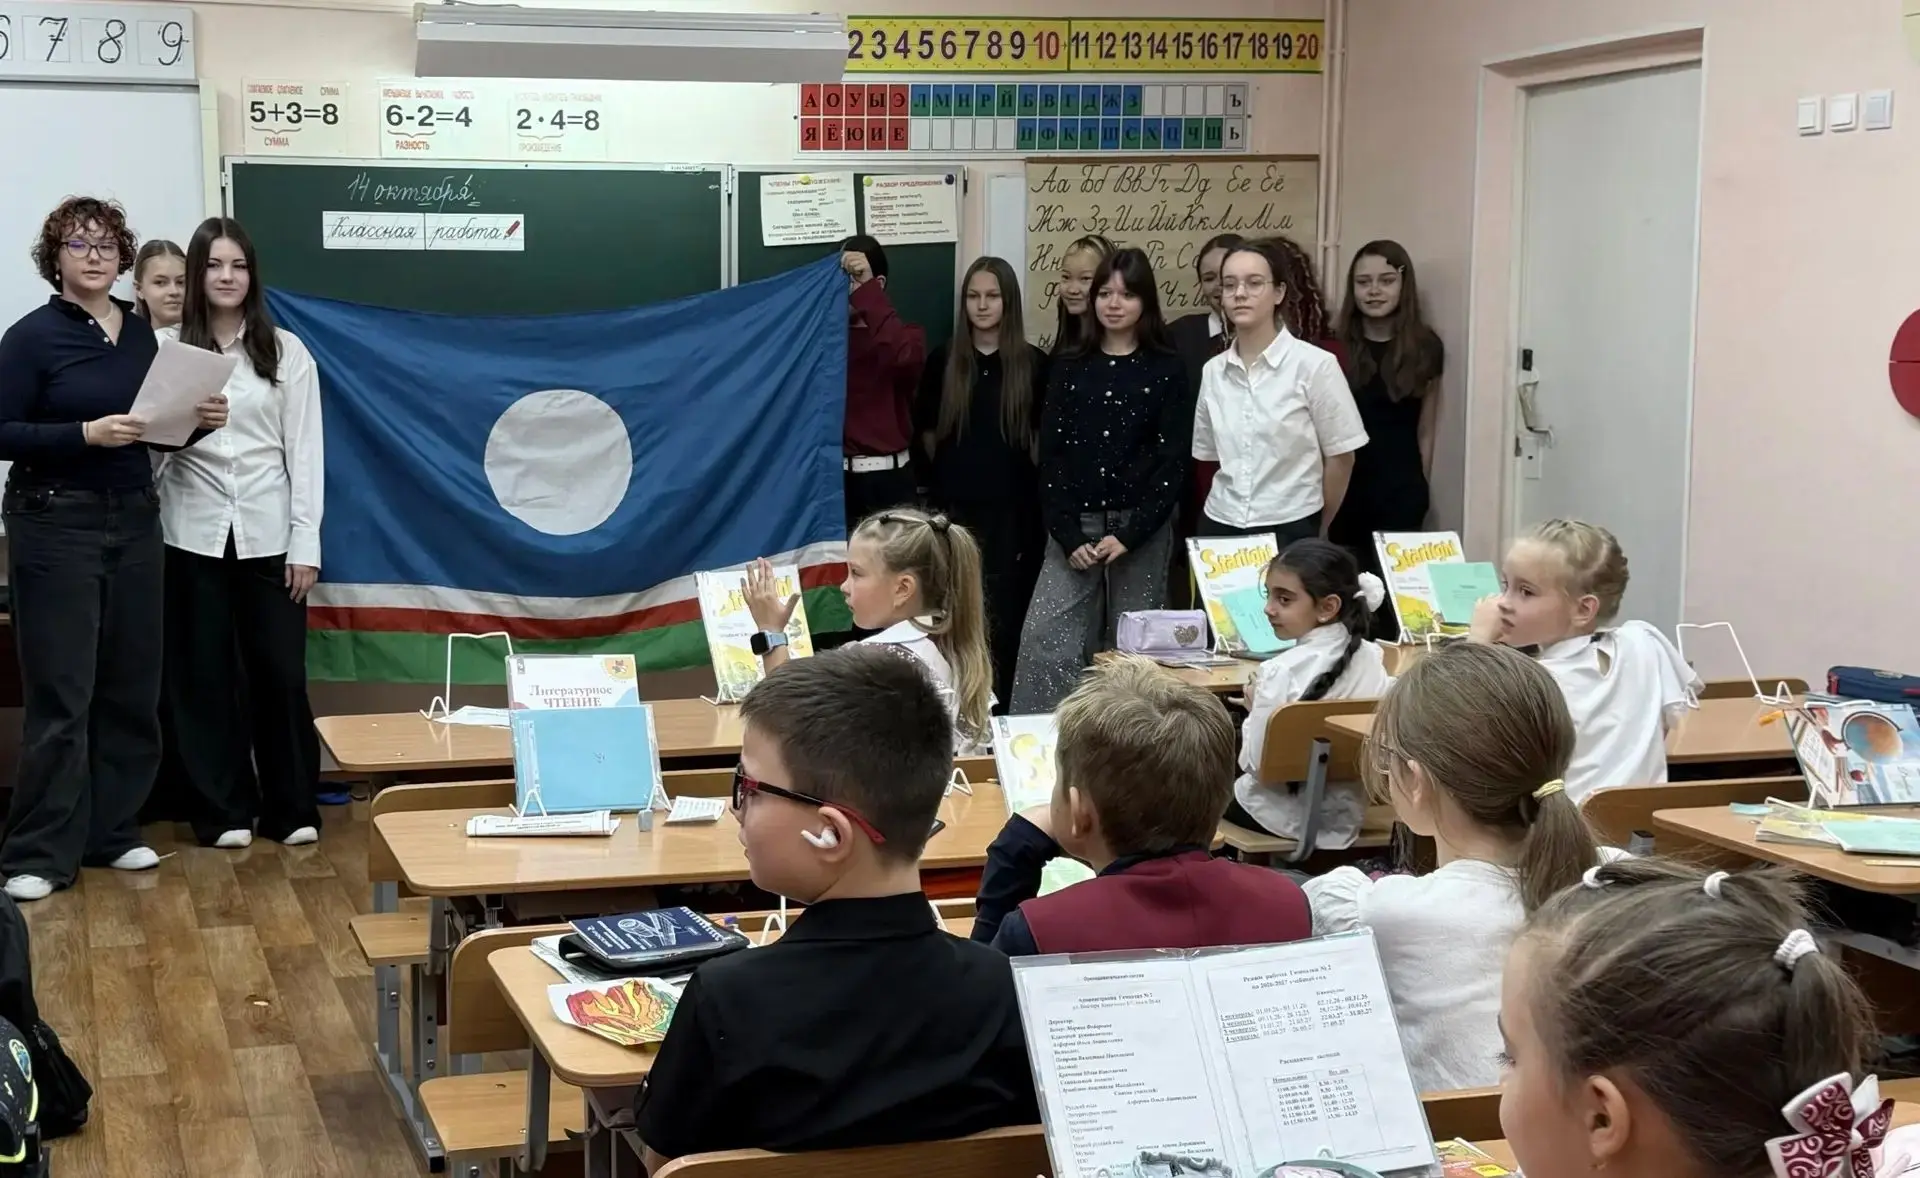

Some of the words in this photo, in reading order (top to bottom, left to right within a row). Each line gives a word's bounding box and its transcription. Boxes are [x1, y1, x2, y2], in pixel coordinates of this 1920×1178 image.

[39, 17, 68, 62] 7
[98, 19, 126, 64] 8
[158, 21, 183, 66] 9
[848, 30, 864, 60] 2
[871, 30, 887, 60] 3
[894, 30, 911, 60] 4
[918, 30, 934, 60] 5
[941, 30, 957, 60] 6
[964, 30, 980, 60] 7
[987, 30, 1002, 60] 8
[1010, 31, 1025, 60] 9
[1033, 31, 1059, 60] 10
[1071, 31, 1089, 60] 11
[1096, 31, 1116, 60] 12
[1121, 31, 1142, 60] 13
[1147, 31, 1168, 60] 14
[1172, 31, 1193, 60] 15
[1198, 31, 1218, 60] 16
[1223, 31, 1244, 60] 17
[1248, 31, 1268, 60] 18
[1272, 31, 1293, 60] 19
[1297, 31, 1318, 60] 20
[250, 100, 339, 125] 5+3=8
[804, 93, 817, 108] А
[826, 93, 840, 108] О
[850, 93, 863, 108] У
[869, 93, 885, 108] Ы
[894, 93, 906, 108] Э
[914, 93, 927, 108] Л
[935, 93, 950, 108] М
[958, 93, 970, 108] Н
[980, 93, 991, 108] Р
[1000, 90, 1013, 108] Й
[1022, 93, 1034, 108] Б
[1044, 93, 1055, 108] В
[1066, 93, 1075, 108] Г
[1084, 93, 1098, 110] Д
[1103, 93, 1121, 108] Ж
[1128, 93, 1138, 108] З
[1229, 93, 1241, 108] Ъ
[386, 104, 473, 127] 6-2=4
[264, 136, 290, 147] СУММА
[395, 140, 430, 150] РАЗНОСТЬ
[348, 171, 371, 202] 14
[1030, 165, 1071, 193] Аа
[1080, 164, 1120, 193] Бб
[1113, 165, 1145, 193] Вв
[1142, 163, 1170, 193] Гг
[1174, 163, 1212, 204] Дд
[1226, 164, 1251, 193] Ее
[1260, 160, 1285, 193] Ёё
[331, 216, 417, 241] Классная
[1028, 204, 1078, 233] Жж
[1082, 204, 1109, 235] Зз
[1113, 204, 1146, 232] Ии
[1147, 200, 1178, 232] Йй
[1178, 203, 1210, 232] Кк
[1241, 203, 1294, 231] Мм
[1386, 539, 1459, 572] Starlight
[529, 684, 613, 697] Литературное
[544, 697, 602, 708] ЧТЕНИЕ
